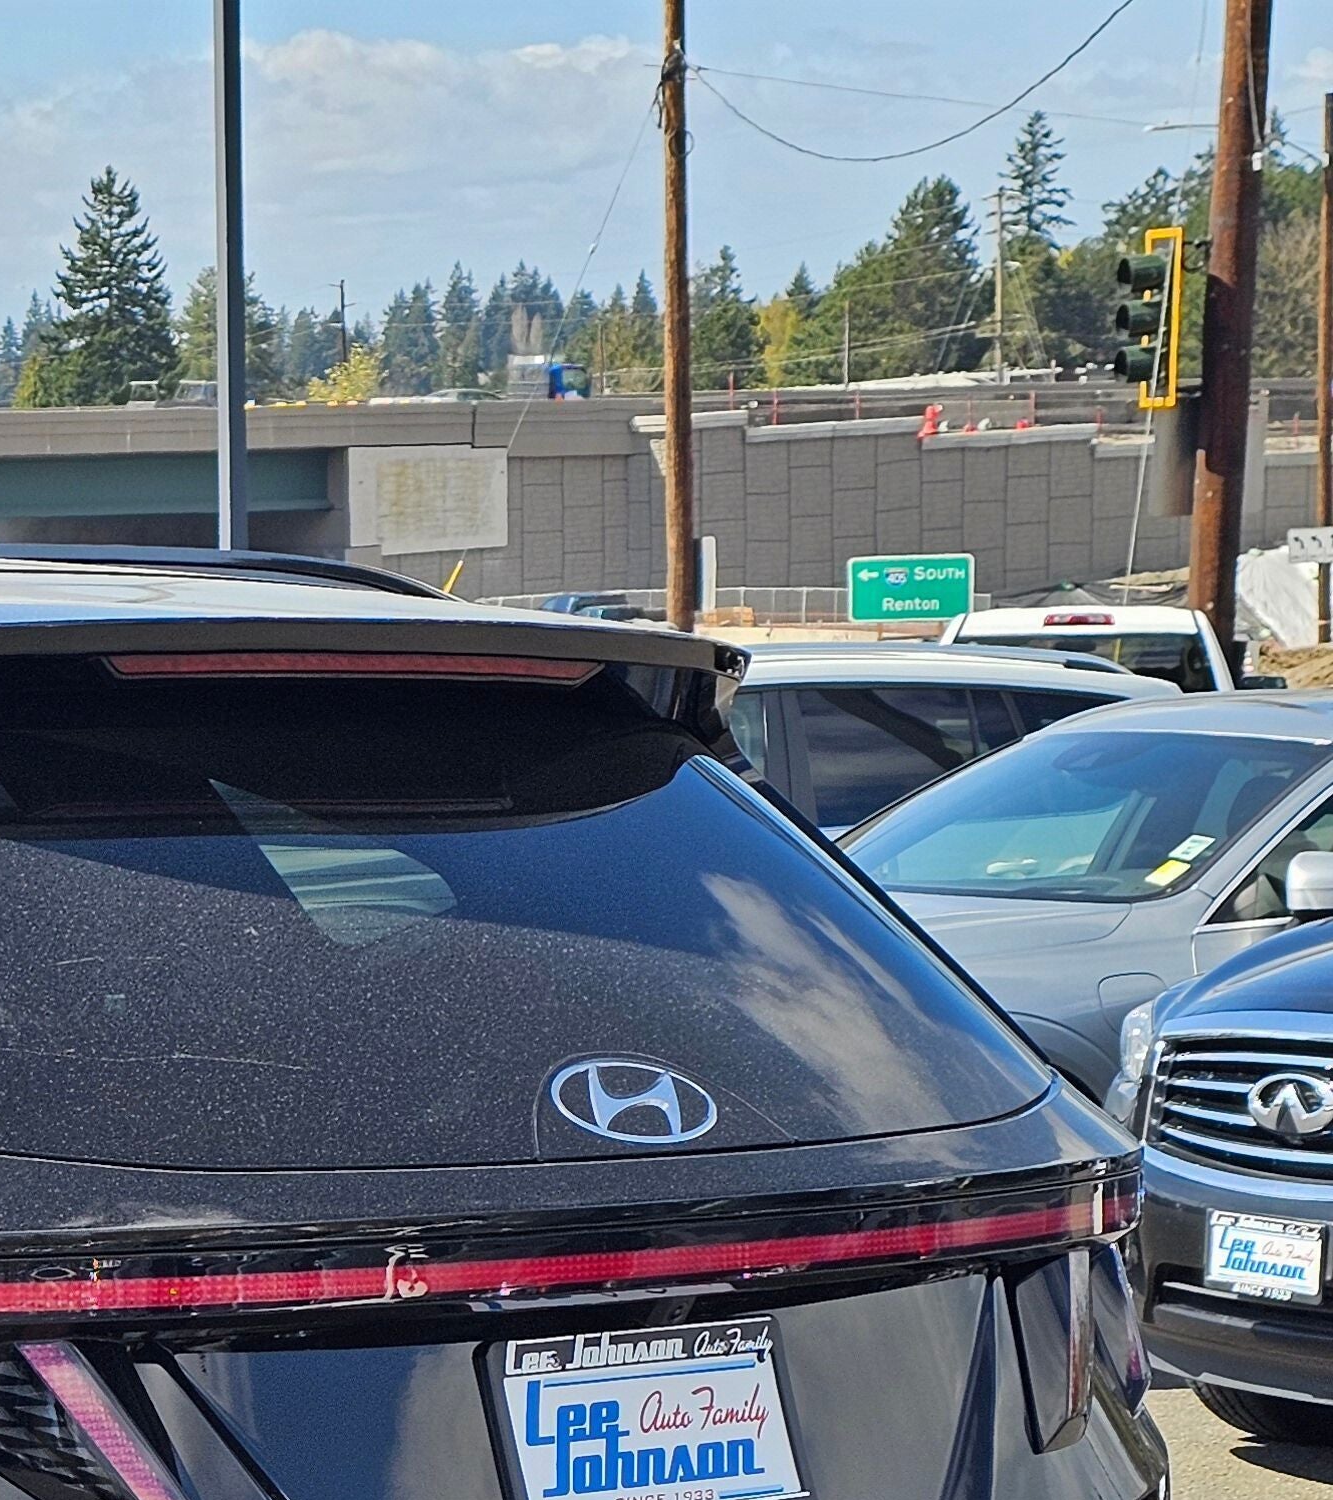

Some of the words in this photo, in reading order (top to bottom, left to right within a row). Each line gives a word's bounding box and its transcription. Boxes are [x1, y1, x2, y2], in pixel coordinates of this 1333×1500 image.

[887, 574, 907, 582] 405
[913, 566, 966, 581] SOUTH
[881, 597, 941, 612] Renton
[1219, 1225, 1257, 1254] Lee
[1219, 1249, 1308, 1281] Johnson
[505, 1340, 563, 1376] Lee
[564, 1331, 688, 1370] Johnson
[693, 1330, 726, 1357] Auto
[725, 1325, 774, 1359] Family
[525, 1379, 630, 1447] Lee
[639, 1390, 694, 1434] Auto
[691, 1383, 770, 1439] Family
[542, 1430, 765, 1499] Johnson
